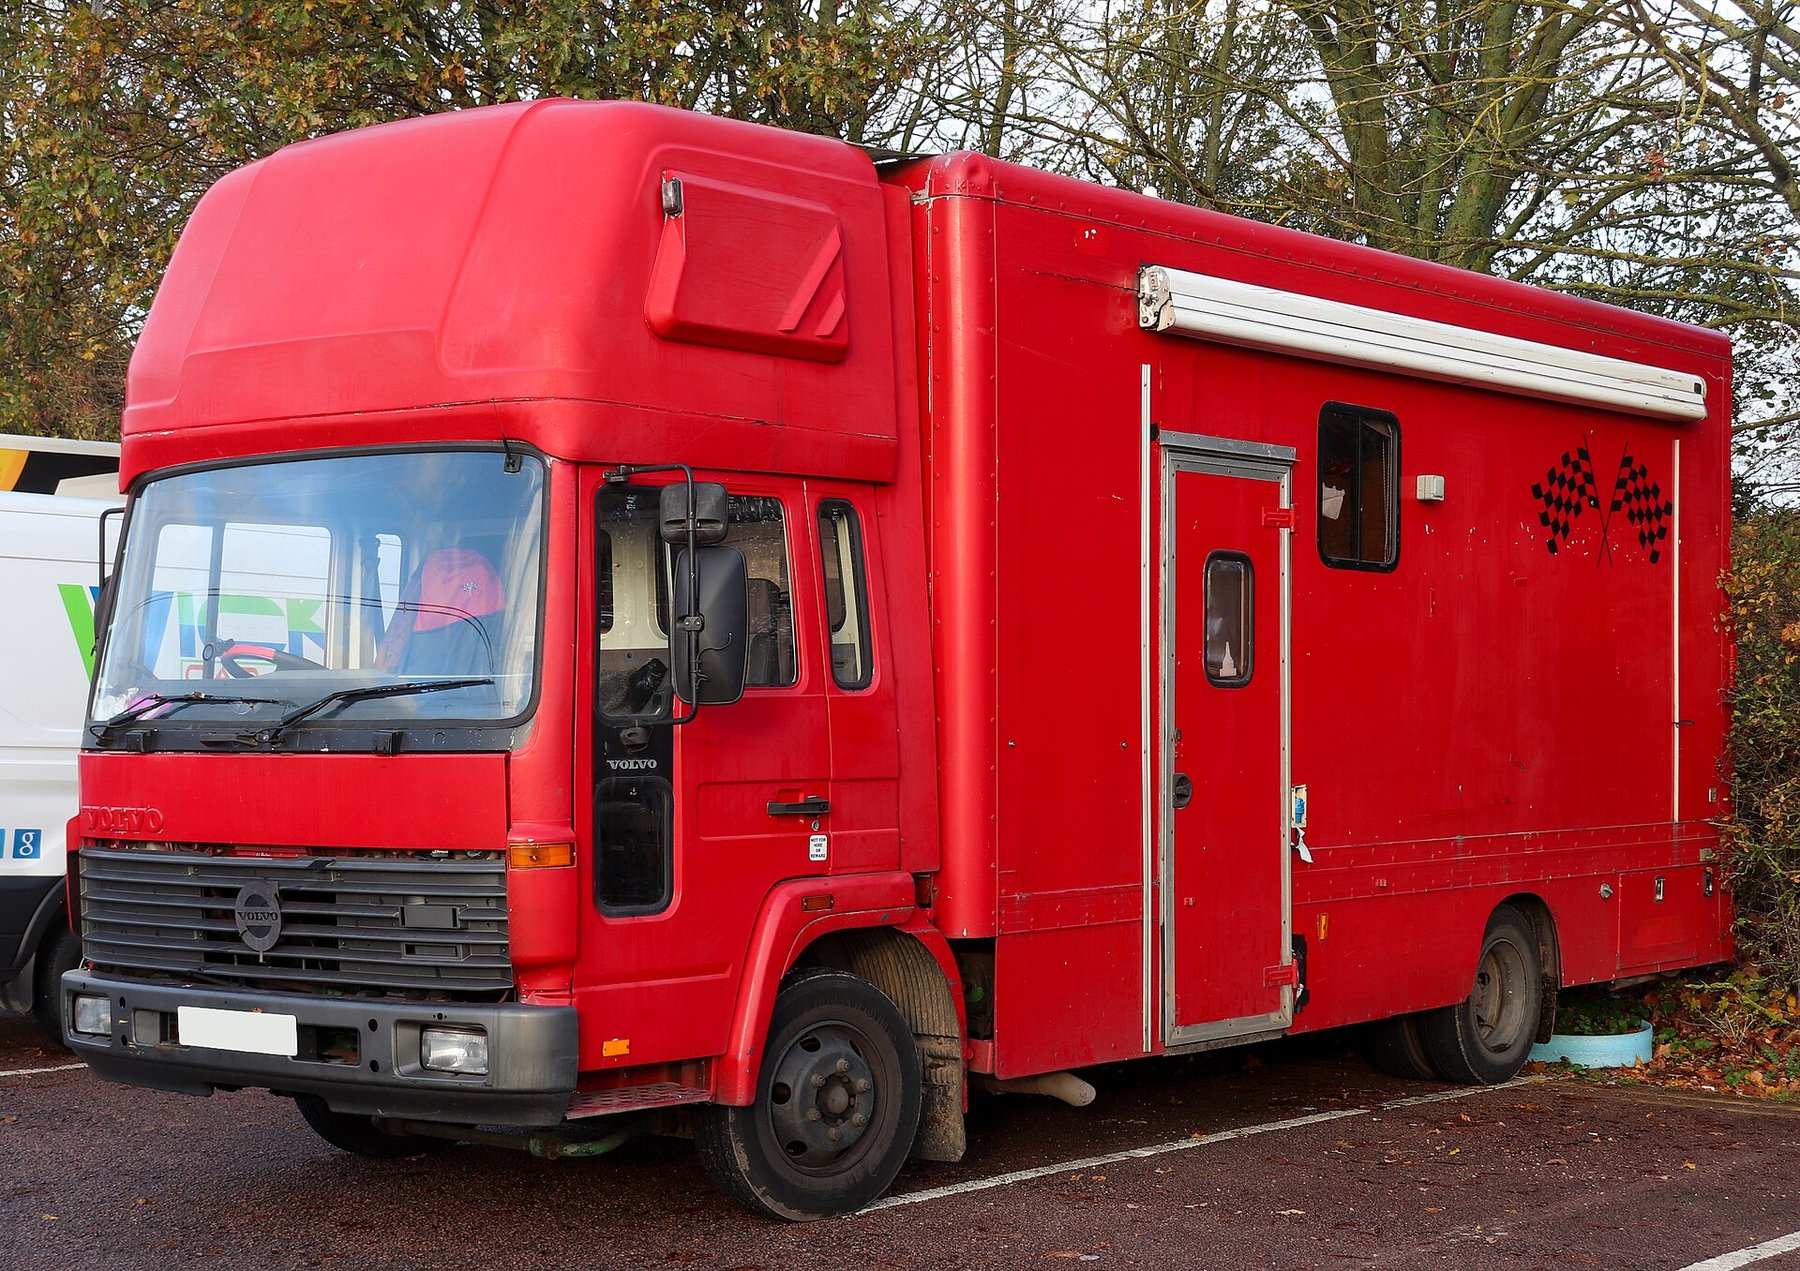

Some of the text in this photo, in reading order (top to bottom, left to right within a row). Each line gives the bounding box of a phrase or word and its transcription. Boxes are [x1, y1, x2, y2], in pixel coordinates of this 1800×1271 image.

[607, 759, 657, 769] VOLVO
[82, 805, 164, 834] VOLVO
[237, 911, 279, 921] VOLVO
